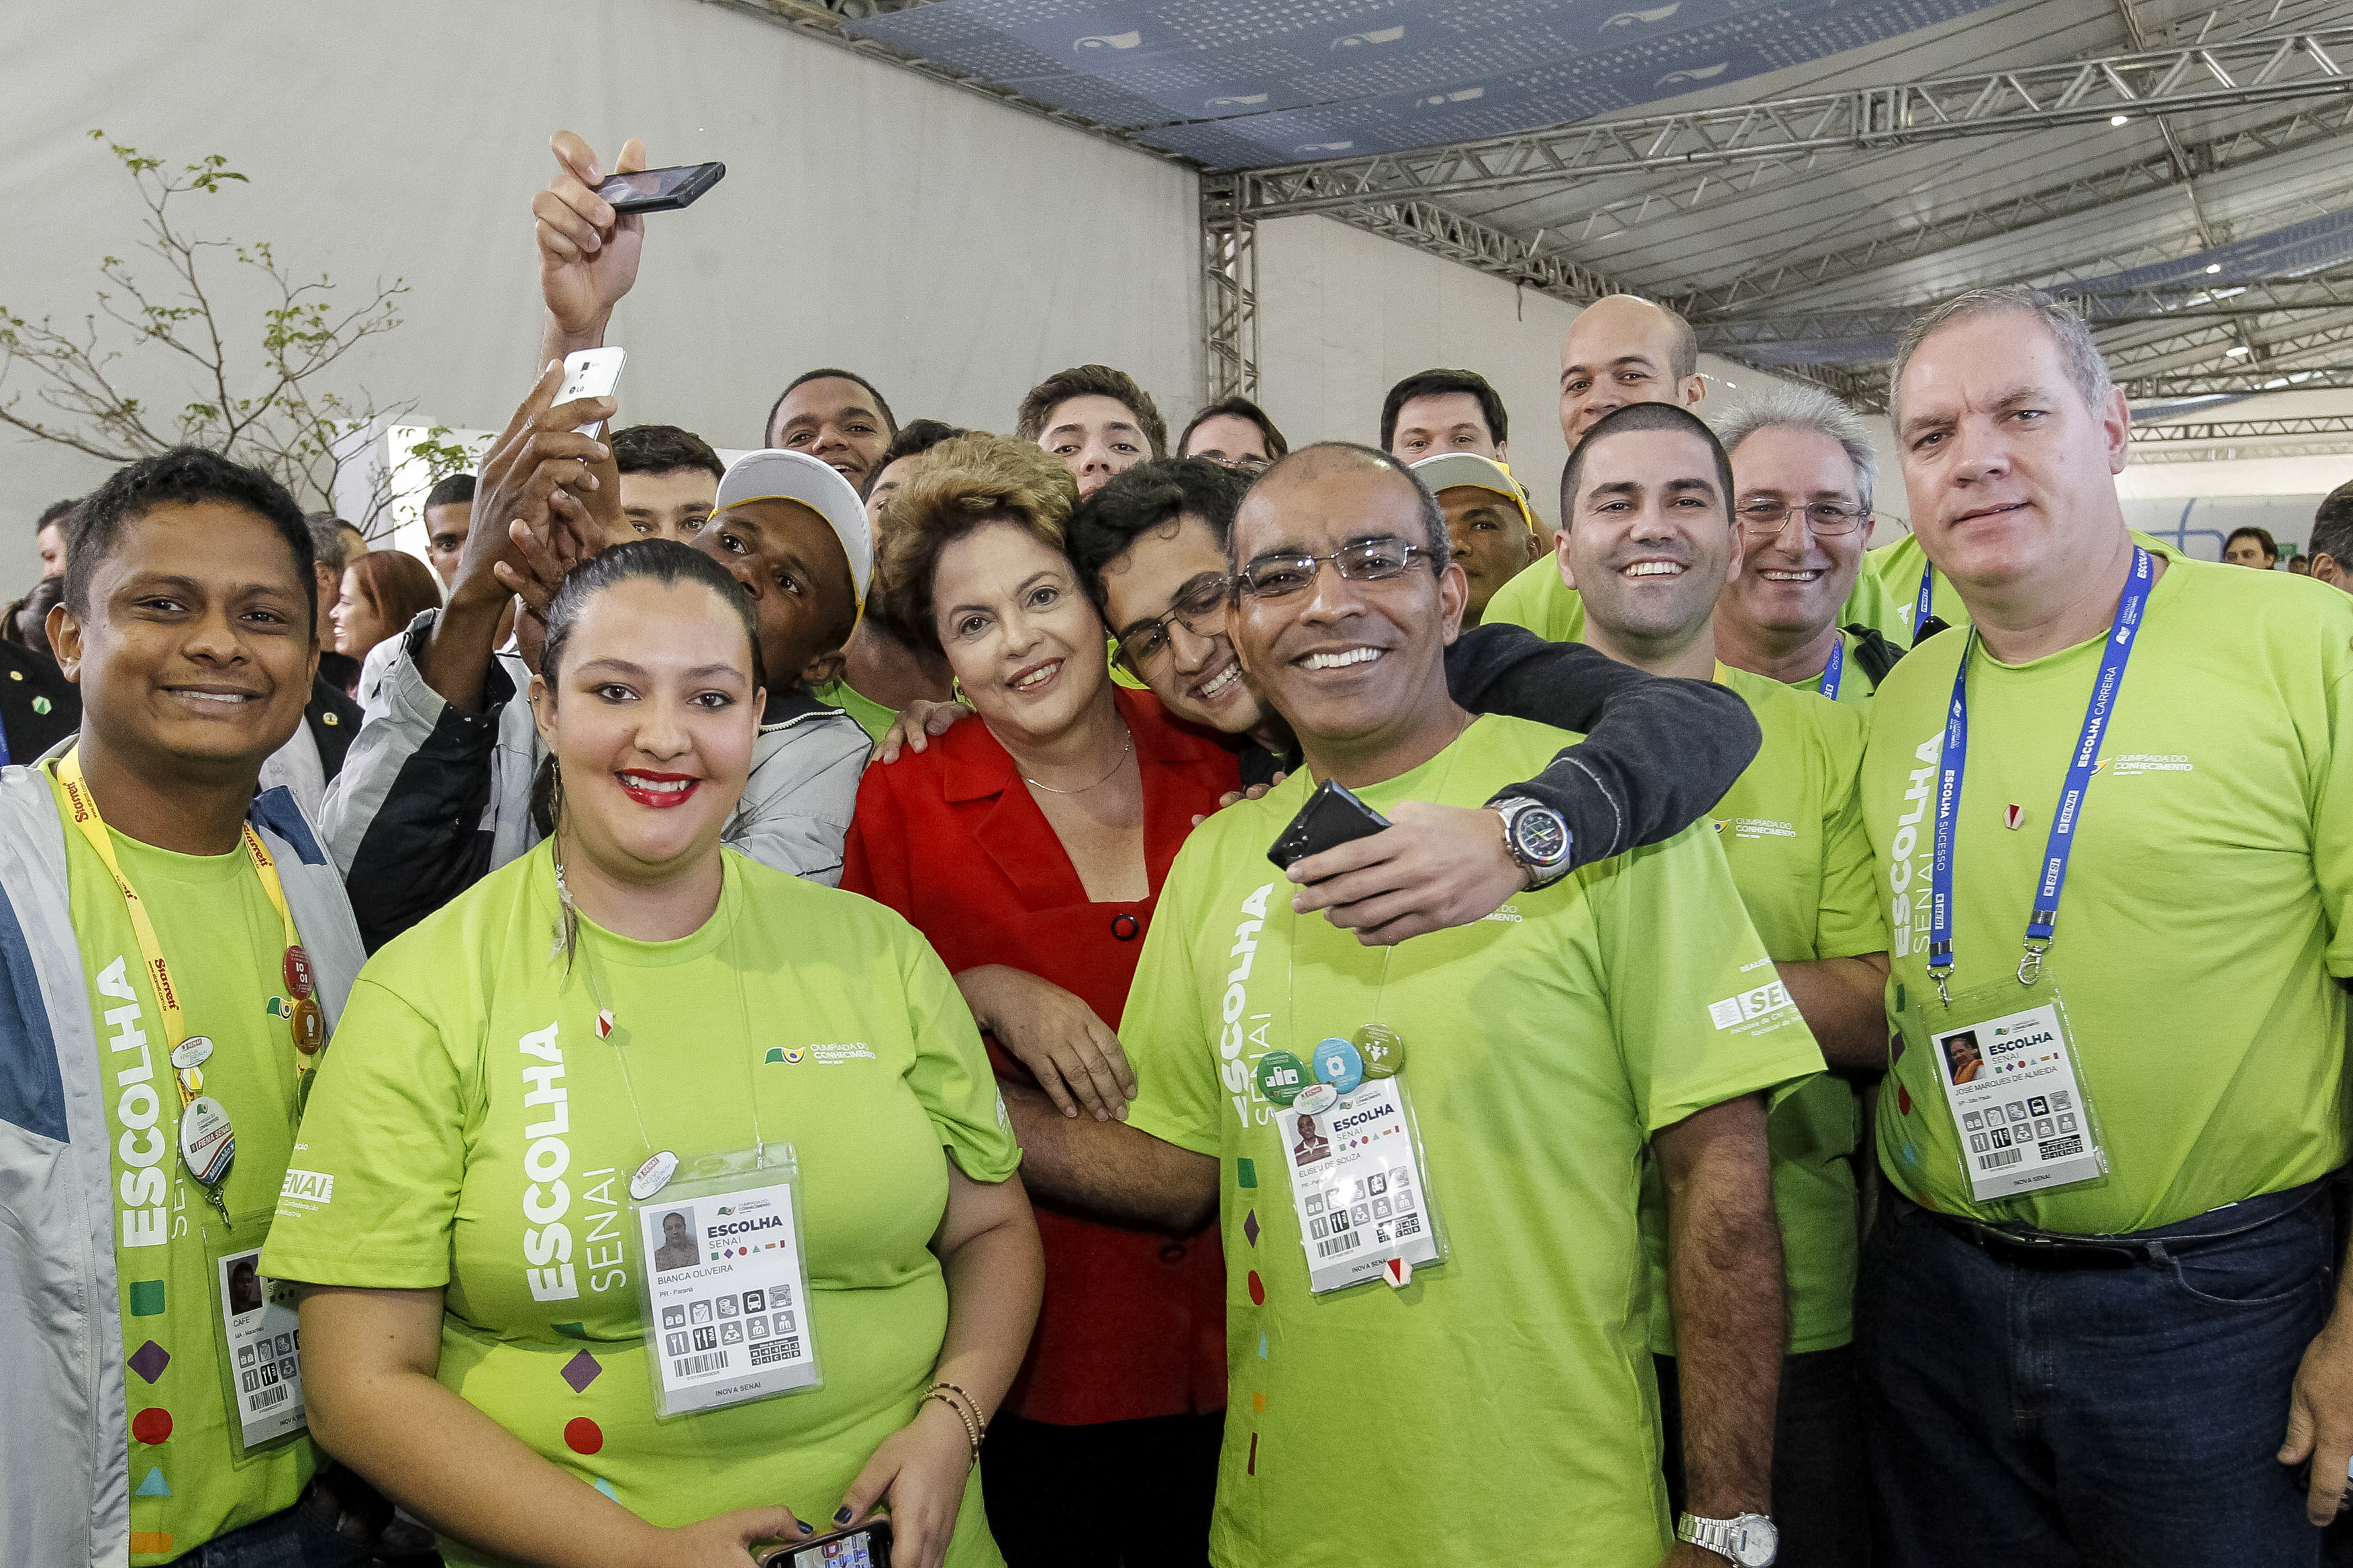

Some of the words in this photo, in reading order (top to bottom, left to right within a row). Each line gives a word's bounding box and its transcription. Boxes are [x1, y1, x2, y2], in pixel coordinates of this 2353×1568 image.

[2077, 717, 2103, 768] ESCOLHA
[2094, 666, 2118, 715] CARREIRA
[2113, 762, 2193, 772] CONHECIMENTO
[2170, 754, 2188, 762] DO
[67, 781, 89, 823] Starrett
[1940, 770, 1955, 819] ESCOLHA
[2062, 792, 2077, 821] SENAI
[1736, 825, 1797, 838] CONHECIMENTO
[1890, 728, 1946, 958] ESCOLHA
[1937, 821, 1948, 871] SUCESSO
[2048, 860, 2060, 884] SESI
[1501, 904, 1517, 913] DO
[1913, 853, 1934, 953] SENAI
[1935, 905, 1944, 929] SESI
[296, 962, 304, 972] 10
[300, 974, 308, 983] 01
[155, 958, 177, 1009] Starrett
[1989, 1032, 2054, 1055] ESCOLHA
[1992, 1052, 2019, 1064] SENAI
[1955, 1085, 1974, 1096] JOSÉ
[1974, 1076, 2012, 1091] MARQUES
[2012, 1074, 2023, 1082] DE
[2024, 1065, 2058, 1079] ALMEIDA
[97, 954, 167, 1248] ESCOLHA
[1333, 1104, 1395, 1133] ESCOLHA
[198, 1134, 215, 1149] FIEMA
[214, 1123, 230, 1139] SENAI
[1337, 1127, 1363, 1141] SENAI
[519, 1021, 579, 1302] ESCOLHA
[1299, 1164, 1323, 1178] ELISEU
[1336, 1153, 1361, 1165] SOUZA
[281, 1173, 328, 1198] ENAI
[583, 1167, 626, 1292] SENAI
[707, 1215, 783, 1238] ESCOLHA
[709, 1236, 742, 1249] SENAI
[658, 1272, 691, 1285] BIANCA
[693, 1264, 734, 1278] OLIVEIRA
[1352, 1263, 1370, 1273] INOVA
[234, 1316, 250, 1327] CAFE
[715, 1386, 739, 1396] INOVA
[740, 1381, 761, 1392] SENAI
[279, 1416, 297, 1426] INOVA
